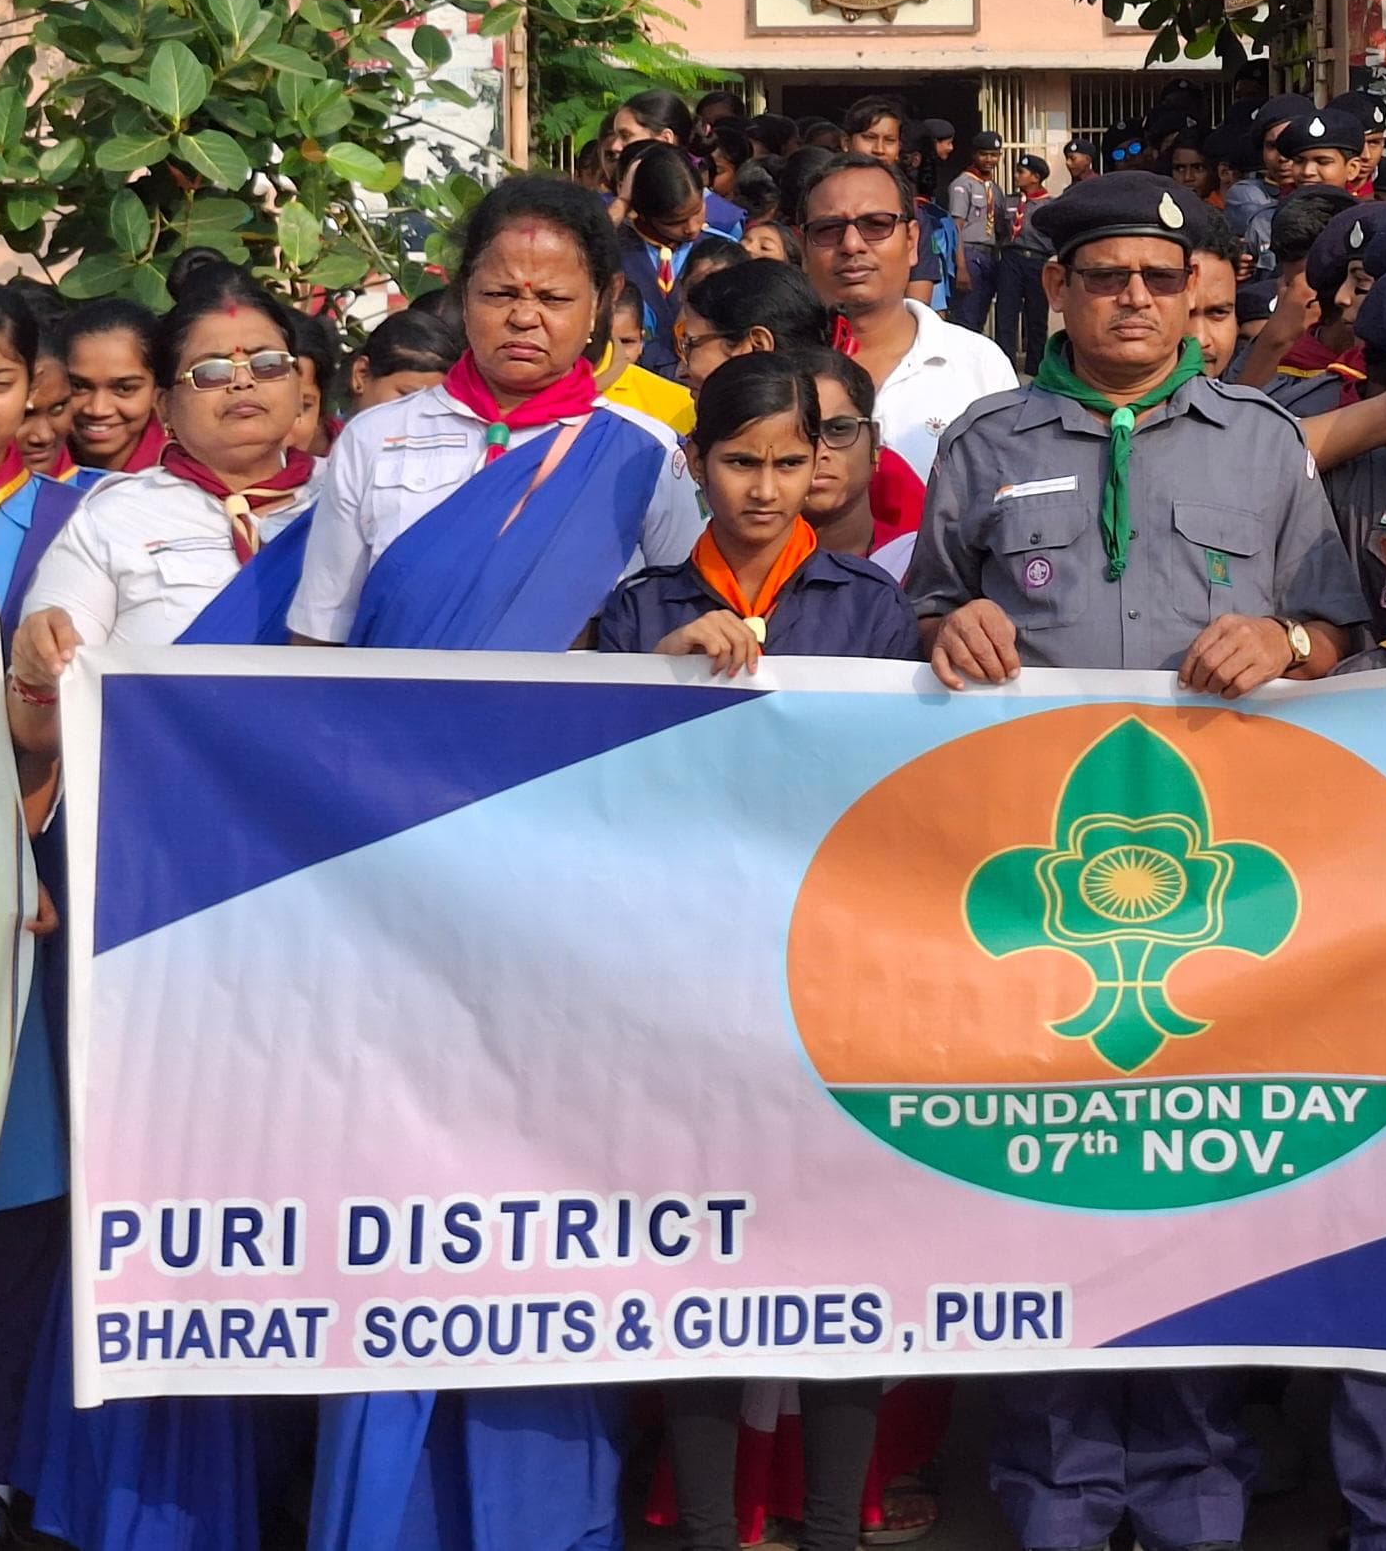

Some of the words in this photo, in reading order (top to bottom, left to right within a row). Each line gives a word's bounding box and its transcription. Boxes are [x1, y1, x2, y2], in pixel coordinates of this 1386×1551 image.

[888, 1085, 1241, 1127] FOUNDATION
[1261, 1084, 1367, 1123] DAY
[1006, 1130, 1119, 1175] 07th
[1143, 1129, 1295, 1175] NOV.
[99, 1205, 297, 1271] PURI
[347, 1199, 747, 1267] DISTRICT
[96, 1306, 329, 1364] BHARAT
[362, 1299, 597, 1358] SCOUTS
[615, 1298, 653, 1351] &
[673, 1290, 884, 1349] GUIDES
[936, 1289, 1063, 1342] PURI
